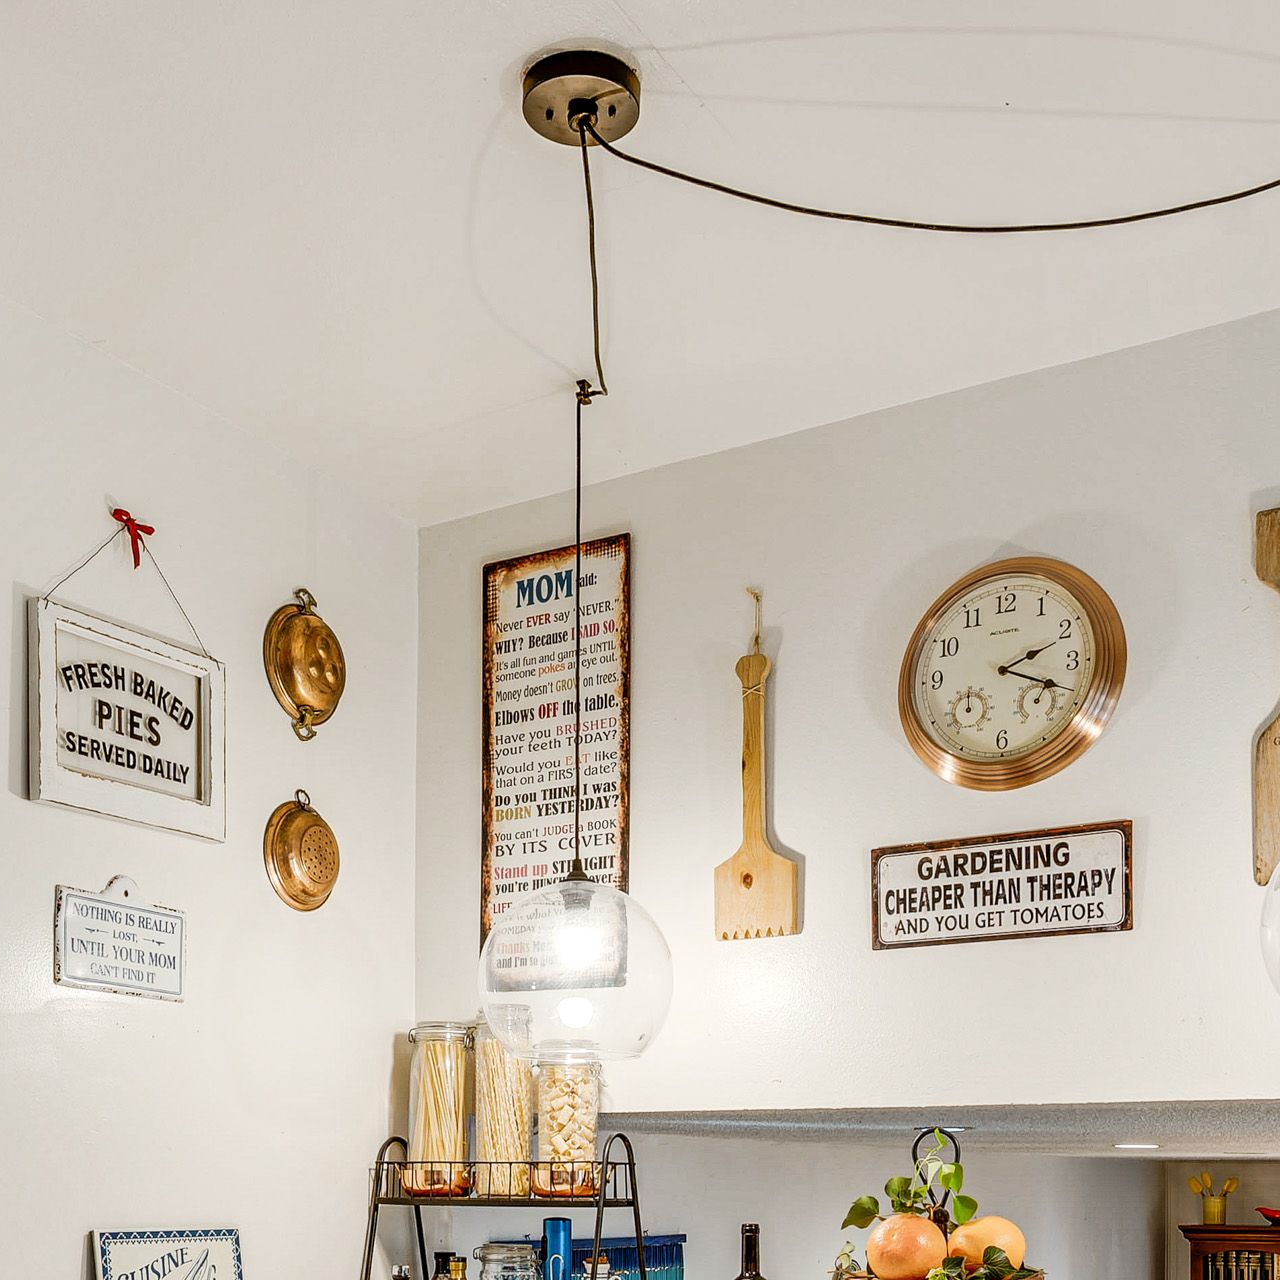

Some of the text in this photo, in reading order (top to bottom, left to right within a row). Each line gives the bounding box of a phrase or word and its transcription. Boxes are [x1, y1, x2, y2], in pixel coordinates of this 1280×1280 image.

[516, 569, 573, 608] MOM
[995, 593, 1017, 615] 12
[1036, 597, 1047, 617] 1
[495, 619, 524, 635] Never
[526, 613, 552, 628] EVER
[554, 610, 570, 623] say
[963, 607, 982, 629] 11
[1058, 619, 1072, 640] 2
[495, 637, 524, 655] WHY?
[528, 630, 569, 649] Because
[571, 627, 576, 641] I
[603, 619, 618, 635] SO.
[939, 636, 960, 658] 10
[495, 668, 536, 684] someone
[538, 661, 566, 678] pokes
[581, 656, 598, 669] eye
[600, 652, 618, 665] out.
[496, 661, 509, 672] It's
[511, 657, 521, 669] all
[523, 654, 537, 667] fun
[539, 650, 555, 663] and
[589, 640, 617, 655] UNTIL
[1066, 650, 1079, 671] 3
[495, 688, 522, 703] Money
[524, 682, 554, 698] doesn't
[583, 675, 594, 688] on
[596, 672, 619, 686] trees.
[931, 670, 944, 690] 9
[61, 663, 194, 730] FRESH BAKED
[97, 699, 161, 746] PIES
[495, 693, 619, 728] Elbows OFF the table.
[495, 730, 618, 760] your teeth TODAY?
[496, 717, 617, 746] Have you BRUSHED
[996, 729, 1009, 750] 6
[65, 731, 190, 784] SERVED DAILY
[495, 750, 618, 776] Would you ET like
[495, 776, 517, 788] that
[520, 776, 535, 786] on
[537, 774, 545, 783] a
[584, 761, 617, 777] date?
[495, 795, 511, 807] Do
[515, 792, 537, 806] you
[583, 783, 589, 795] I
[592, 781, 618, 794] was
[495, 794, 620, 822] BORN YESTERDAY?
[495, 831, 513, 843] You
[515, 828, 540, 840] can't
[542, 823, 575, 837] JUDGE
[587, 819, 617, 832] BOOK
[495, 832, 617, 857] BY ITS COVER
[494, 864, 529, 880] Stand
[532, 864, 549, 878] up
[917, 841, 1070, 881] GARDENING
[495, 880, 529, 896] you're
[885, 867, 1117, 916] CHEAPER THAN THERAPY
[73, 902, 177, 935] NOTHING IS REALLY
[894, 901, 1105, 936] AND YOU GET TOMATOES
[71, 937, 176, 970] UNTIL YOUR MOM
[90, 962, 156, 984] CAN'T FIND IT
